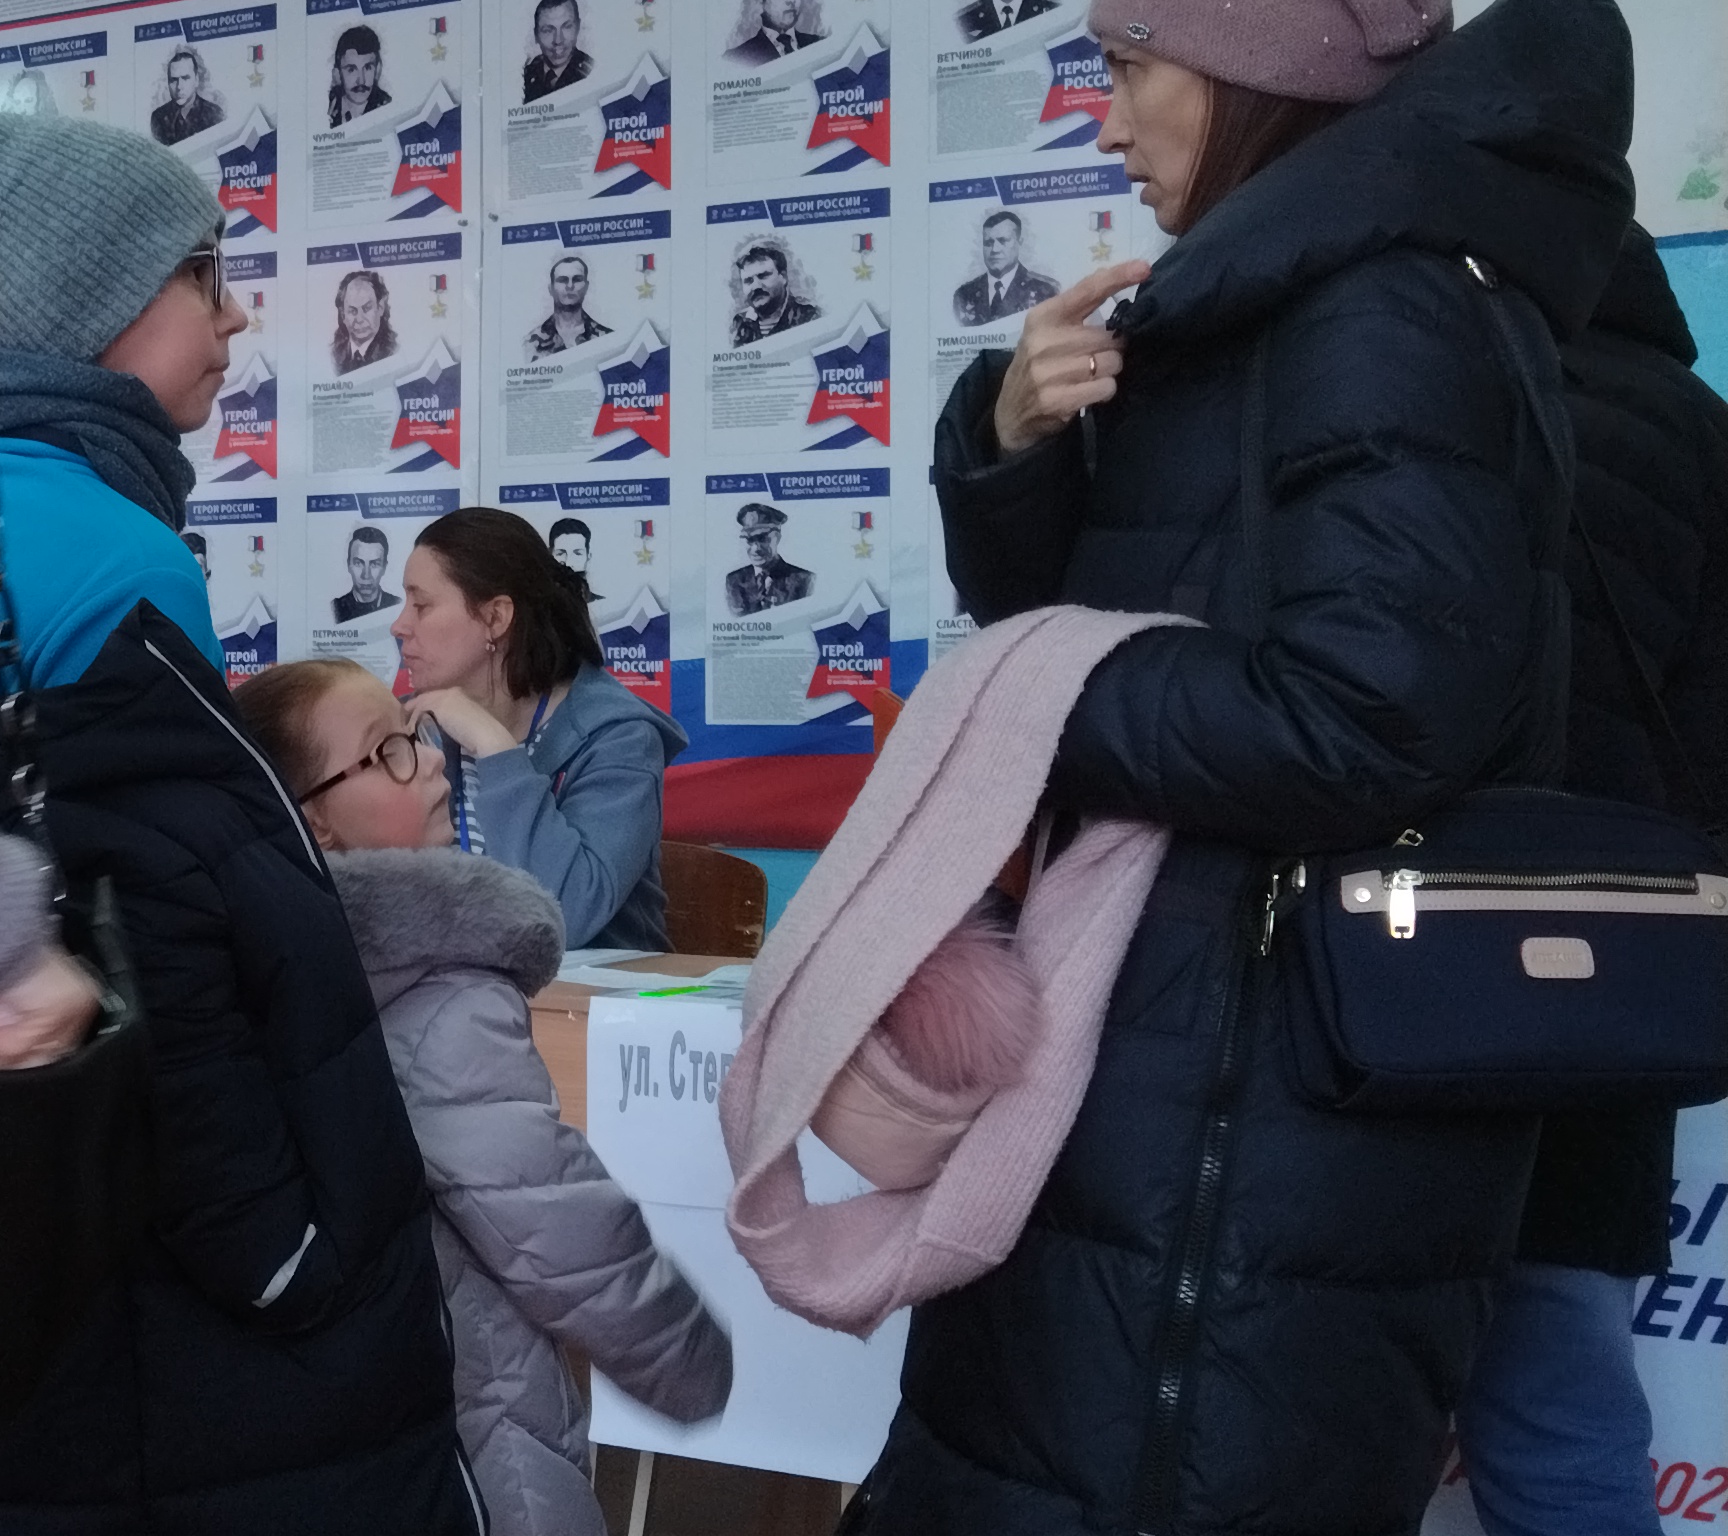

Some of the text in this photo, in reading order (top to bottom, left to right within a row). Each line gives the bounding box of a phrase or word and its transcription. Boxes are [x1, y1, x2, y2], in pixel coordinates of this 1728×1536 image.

[937, 47, 992, 63] ВЕТЧИНОВ
[1057, 55, 1102, 76] ГЕРОЙ
[714, 76, 761, 91] РОМАНОВ
[1064, 73, 1113, 90] РОССИ
[823, 84, 864, 105] ГЕРОЙ
[508, 103, 554, 117] КУЗНЕЦОВ
[829, 99, 883, 119] РОССИИ
[609, 111, 647, 131] ГЕРОЙ
[615, 126, 664, 145] РОССИИ
[405, 137, 439, 156] ГЕРОЙ
[410, 151, 455, 169] РОССИИ
[225, 161, 257, 178] ГЕРОЙ
[230, 175, 272, 191] РОССИИ
[1010, 171, 1098, 191] ГЕРОИ РОССИИ
[780, 195, 860, 213] ГЕРОИ РОССИИ
[570, 217, 643, 235] ГЕРОИ РОССИИ
[227, 259, 254, 270] ОССИИ
[936, 333, 1006, 346] ТИМОШЕНКО
[713, 350, 761, 362] МОРОЗОВ
[506, 364, 563, 377] ОХРИМЕНКО
[823, 364, 864, 382] ГЕРОЙ
[313, 380, 353, 392] РУШАЙЛО
[608, 377, 646, 395] ГЕРОЙ
[829, 380, 883, 396] РОССИИ
[404, 393, 439, 410] ГЕРОЙ
[614, 393, 663, 409] РОССИИ
[225, 407, 257, 422] ГЕРОЙ
[409, 408, 454, 424] РОССИИ
[230, 421, 272, 434] РОССИИ
[780, 473, 860, 487] ГЕРОИ РОССИИ
[568, 483, 642, 497] ГЕРОИ РОССИИ
[193, 503, 254, 514] ГЕРОИ РОССИИ
[713, 622, 772, 632] НОВОСЕЛОВ
[936, 619, 976, 629] СЛАСТЕ
[226, 649, 257, 662] ГЕРОЙ
[608, 644, 646, 659] ГЕРОЙ
[822, 641, 864, 657] ГЕРОЙ
[614, 661, 664, 672] РОССИИ
[829, 659, 882, 672] РОССИИ
[619, 1044, 658, 1113] ул.
